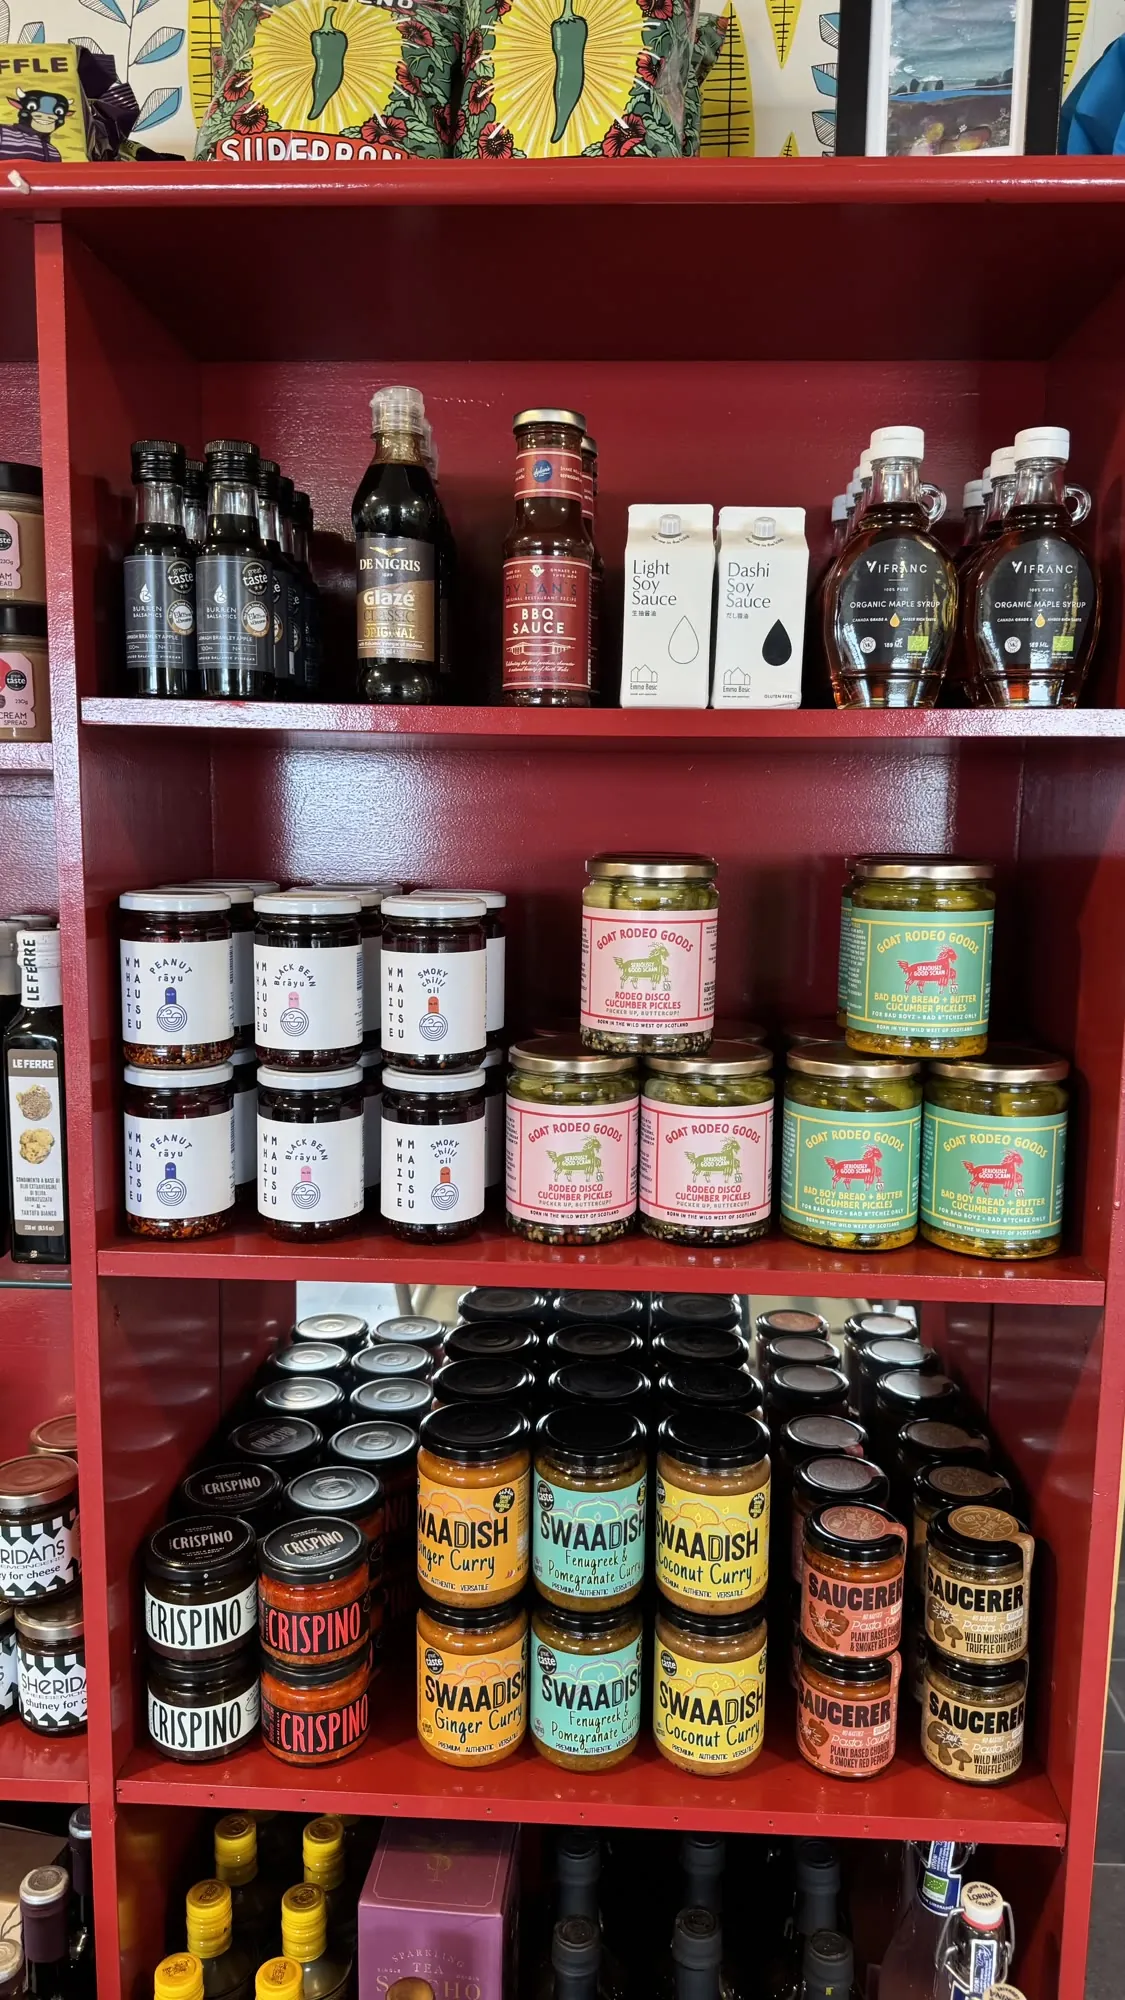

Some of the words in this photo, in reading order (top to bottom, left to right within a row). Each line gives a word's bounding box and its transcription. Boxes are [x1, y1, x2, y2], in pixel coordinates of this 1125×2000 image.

[360, 559, 373, 570] DE
[375, 559, 420, 572] NIGRIS
[633, 560, 670, 578] Light
[728, 562, 770, 578] Dashi
[866, 560, 927, 574] VIFRANC
[1012, 561, 1074, 574] VIFRANC
[168, 574, 193, 585] taste
[243, 574, 268, 585] taste
[632, 576, 660, 594] Soy
[727, 578, 754, 596] Soy
[364, 590, 415, 606] Glazé
[632, 591, 677, 606] Sauce
[726, 594, 771, 608] Sauce
[850, 601, 887, 609] ORGANIC
[889, 600, 915, 608] MAPLE
[994, 601, 1032, 609] ORGANIC
[1034, 600, 1060, 608] MAPLE
[1062, 601, 1086, 609] SYRUP
[364, 609, 415, 622] CLASSIC
[522, 608, 554, 621] BBQ
[513, 622, 565, 634] SAUCE
[596, 931, 617, 950] GOAT
[620, 928, 657, 938] RODEO
[660, 930, 694, 952] GOODS
[877, 933, 901, 953] GOAT
[905, 930, 946, 941] RODEO
[949, 932, 979, 955] GOODS
[23, 939, 38, 982] FERRE
[149, 958, 192, 974] PEANUT
[274, 964, 294, 986] BLACK
[298, 965, 316, 988] BEAN
[417, 968, 448, 979] SMOKY
[27, 986, 40, 1001] LE
[615, 992, 643, 1000] RODEO
[645, 992, 670, 1001] DISCO
[874, 992, 889, 1001] BAD
[891, 993, 908, 1002] BOY
[912, 994, 939, 1003] BREAD
[950, 995, 976, 1003] BUTTER
[605, 999, 647, 1009] CUCUMBER
[650, 1001, 681, 1009] PICKLES
[886, 1003, 932, 1012] CUCUMBER
[935, 1004, 967, 1012] PICKLES
[13, 1059, 23, 1068] LE
[24, 1059, 54, 1069] FERRE
[528, 1125, 549, 1143] GOAT
[553, 1123, 590, 1133] RODEO
[594, 1124, 623, 1142] GOODS
[665, 1126, 688, 1144] GOAT
[692, 1124, 729, 1134] RODEO
[732, 1125, 760, 1144] GOODS
[805, 1131, 828, 1149] GOAT
[832, 1129, 871, 1140] RODEO
[874, 1132, 904, 1152] GOODS
[149, 1134, 192, 1150] PEANUT
[430, 1139, 460, 1149] SMOKY
[943, 1135, 966, 1152] GOAT
[970, 1133, 1012, 1145] RODEO
[1014, 1136, 1048, 1159] GOODS
[285, 1139, 307, 1161] BLACK
[311, 1140, 328, 1162] BEAN
[548, 1184, 576, 1192] RODEO
[579, 1183, 602, 1192] DISCO
[686, 1185, 715, 1193] RODEO
[717, 1185, 741, 1193] DISCO
[803, 1185, 817, 1195] BAD
[819, 1189, 836, 1199] BOY
[838, 1191, 866, 1201] BREAD
[876, 1190, 903, 1200] BUTTER
[538, 1191, 581, 1201] CUCUMBER
[583, 1191, 612, 1200] PICKLES
[675, 1192, 720, 1202] CUCUMBER
[723, 1192, 750, 1201] PICKLES
[815, 1197, 860, 1209] CUCUMBER
[862, 1199, 892, 1209] PICKLES
[941, 1188, 954, 1199] BAD
[957, 1193, 973, 1202] BOY
[976, 1195, 1004, 1206] BREAD
[1016, 1198, 1045, 1207] BUTTER
[952, 1201, 998, 1214] CUCUMBER
[1001, 1206, 1034, 1215] PICKLES
[204, 1476, 261, 1495] CRISPINO
[538, 1492, 553, 1502] taste
[541, 1505, 644, 1551] SWAADISH
[173, 1530, 233, 1550] CRISPINO
[284, 1531, 344, 1556] CRISPINO
[450, 1549, 495, 1579] Curry
[565, 1550, 618, 1575] Fenugreek
[622, 1547, 627, 1562] &
[658, 1542, 703, 1582] Coconut
[710, 1563, 752, 1590] Curry
[549, 1560, 614, 1591] Pomegranate
[927, 1566, 1024, 1612] SAUCERER
[150, 1599, 241, 1646] CRISPINO
[269, 1602, 360, 1655] CRISPINO
[851, 1630, 870, 1641] PLANT
[871, 1628, 887, 1640] BASED
[426, 1658, 443, 1667] taste
[538, 1656, 556, 1666] taste
[425, 1667, 526, 1712] SWAADISH
[25, 1700, 59, 1711] chutney
[63, 1699, 77, 1708] for
[660, 1681, 763, 1725] SWAADISH
[570, 1708, 620, 1733] Fenugreek
[624, 1703, 628, 1717] &
[929, 1691, 1024, 1734] SAUCERER
[152, 1701, 241, 1749] CRISPINO
[281, 1693, 368, 1754] CRISPINO
[435, 1708, 482, 1743] Ginger
[489, 1703, 522, 1730] Curry
[666, 1713, 720, 1747] Coconut
[727, 1720, 760, 1745] Curry
[584, 1744, 612, 1753] AUTHENTIC
[831, 1745, 848, 1757] PLANT
[850, 1748, 869, 1758] BASED
[830, 1755, 834, 1764] &
[835, 1757, 858, 1768] SMOKEY
[859, 1757, 869, 1768] RED
[974, 1754, 990, 1764] WILD
[975, 1765, 1001, 1774] TRUFFLE
[967, 1891, 997, 1902] LORINA
[392, 1948, 464, 1969] SPARKLING
[413, 1962, 444, 1975] TEA
